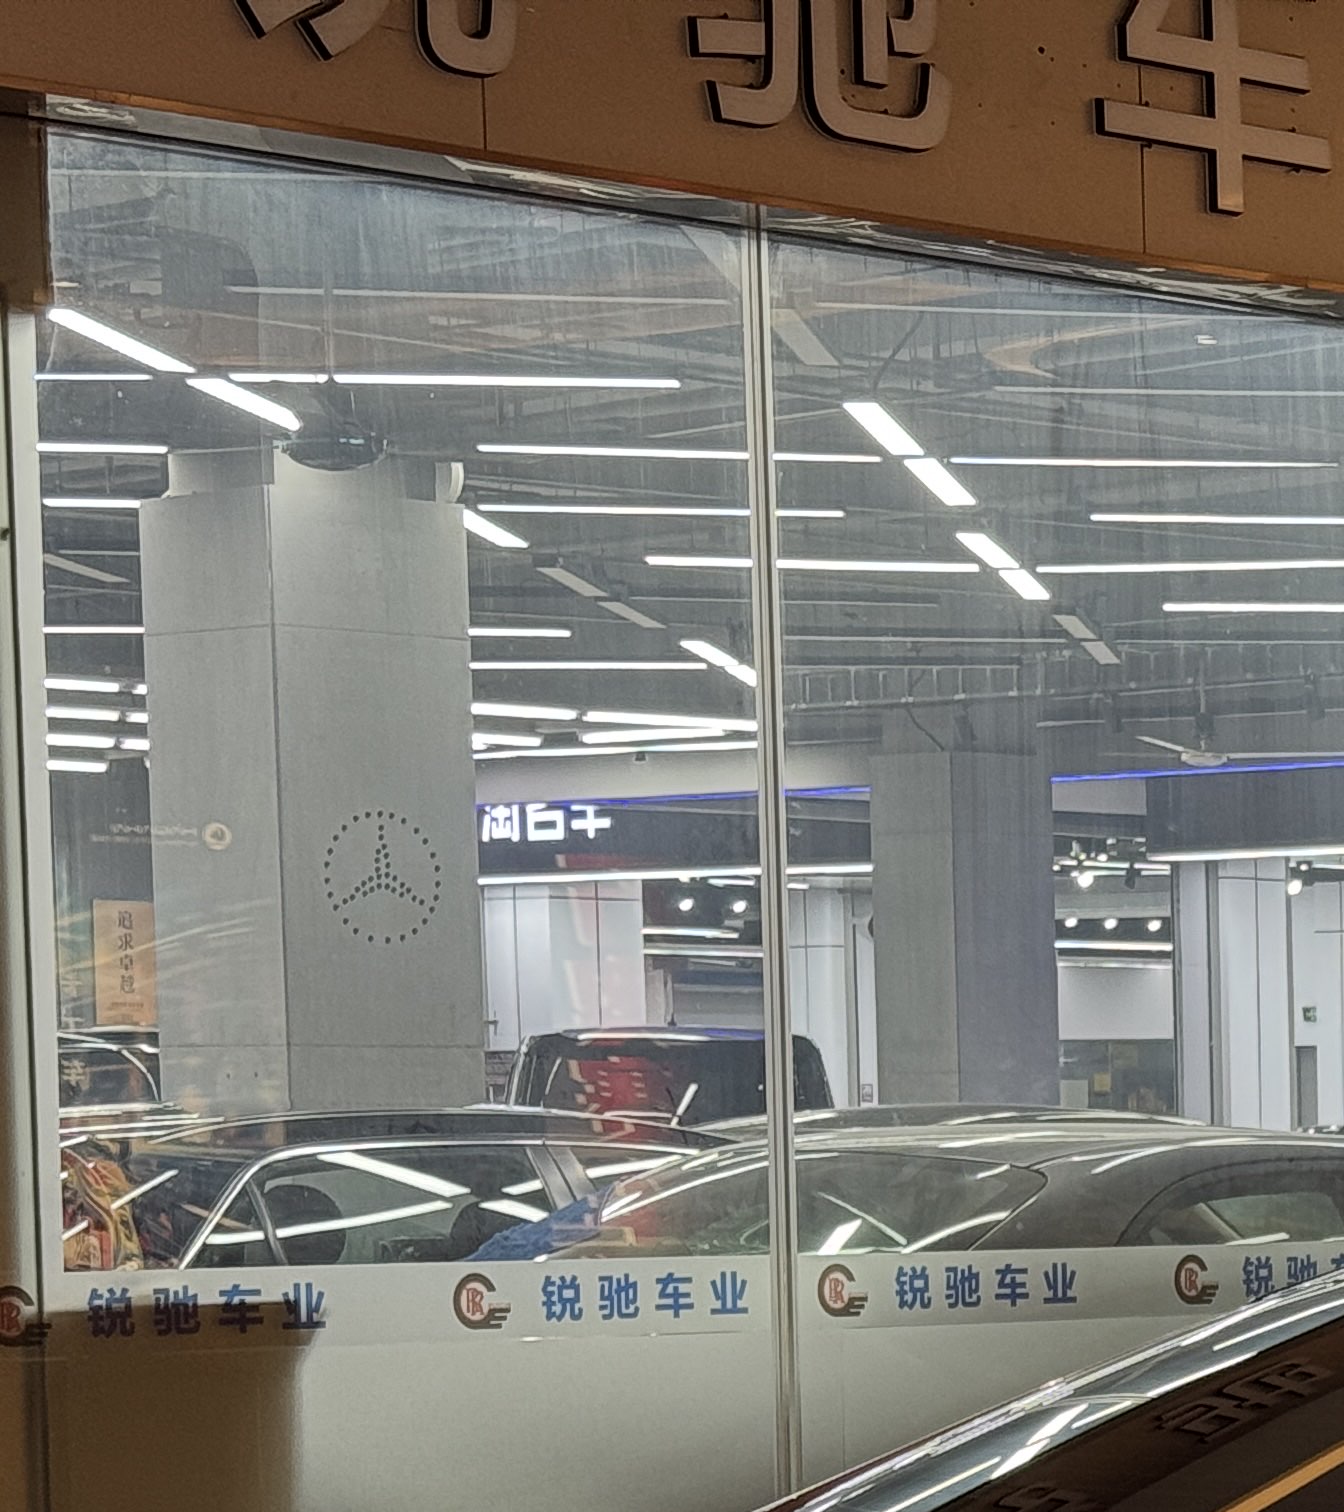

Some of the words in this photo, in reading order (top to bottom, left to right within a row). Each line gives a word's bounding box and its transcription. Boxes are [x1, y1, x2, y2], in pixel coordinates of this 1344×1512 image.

[86, 1282, 327, 1339] 锐驰车业
[541, 1270, 750, 1323] 锐驰车业
[895, 1261, 1078, 1312] 锐驰车业
